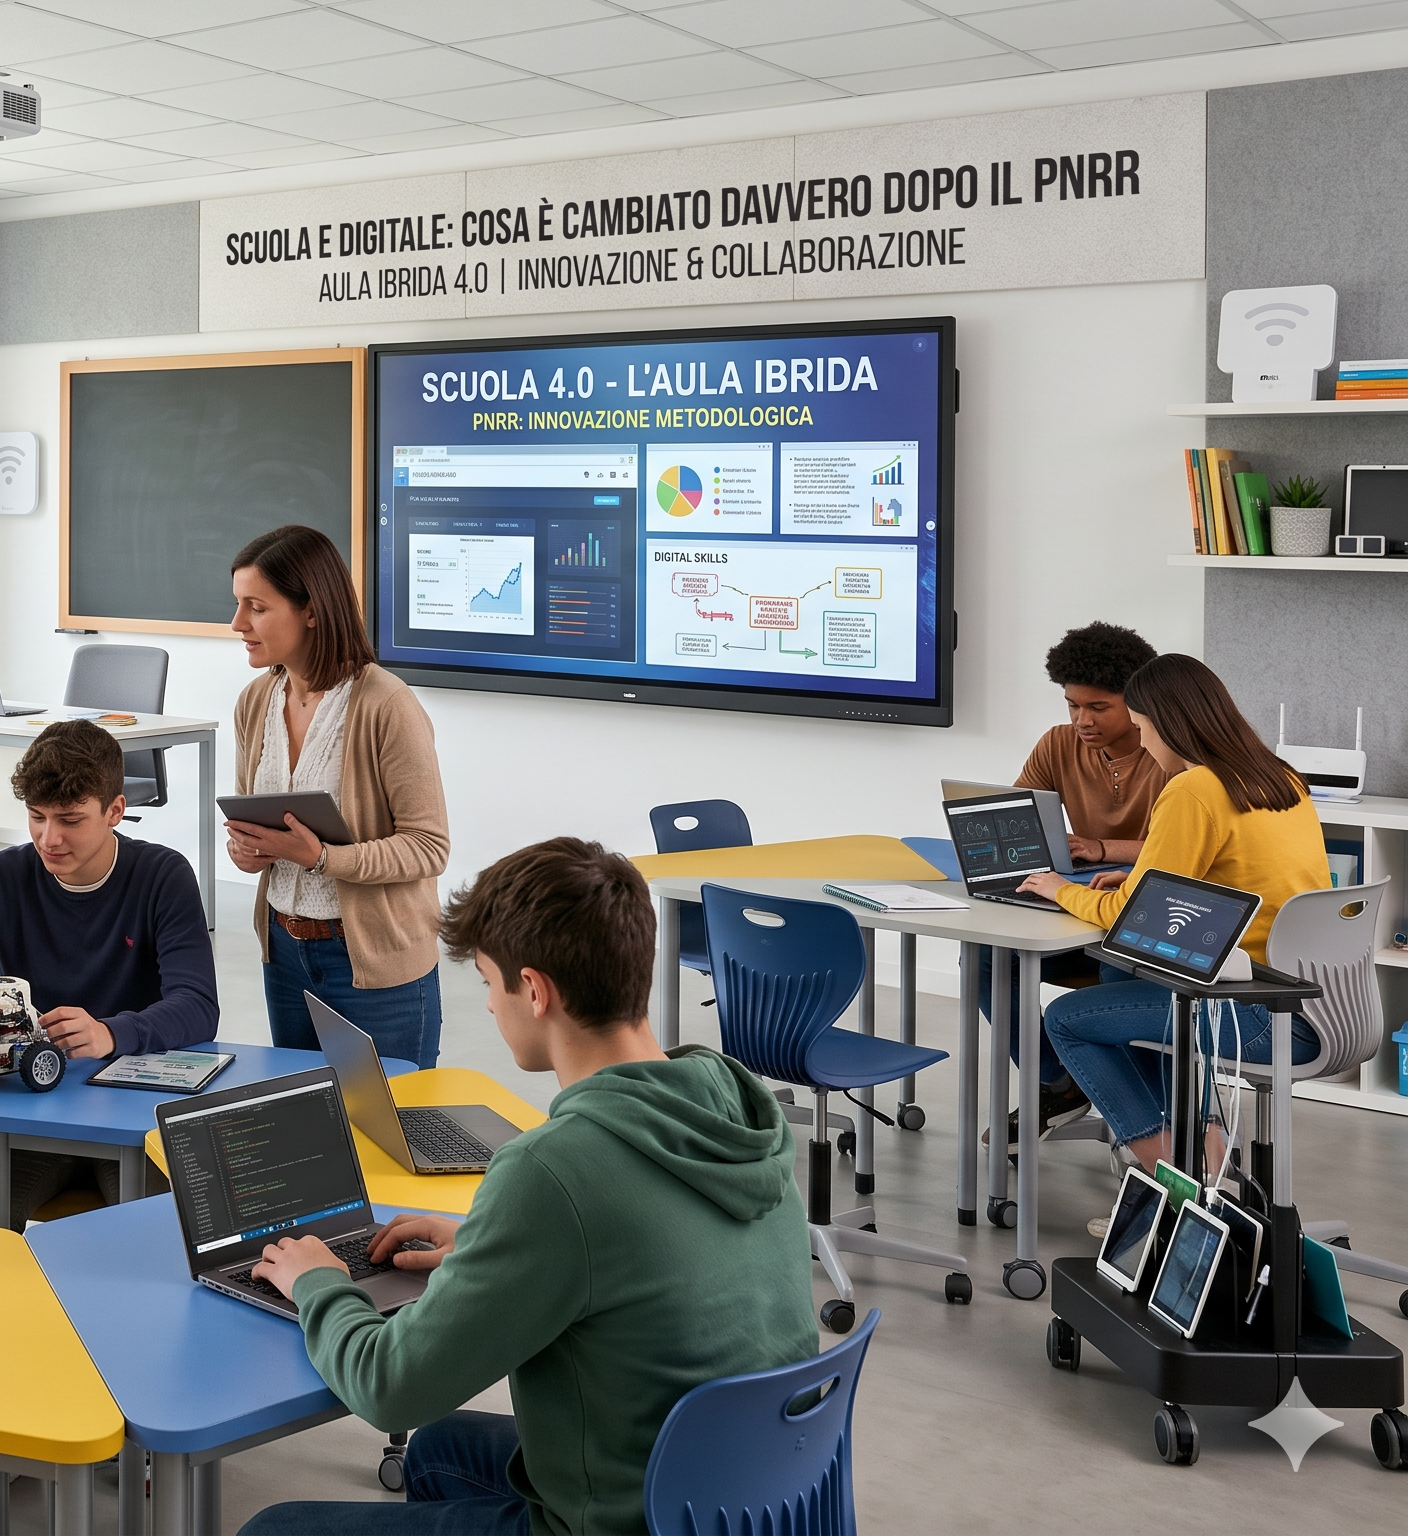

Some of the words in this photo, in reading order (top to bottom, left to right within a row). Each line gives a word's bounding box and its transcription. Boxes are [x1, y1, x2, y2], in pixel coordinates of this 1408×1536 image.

[226, 226, 312, 266] SCUOLA
[319, 224, 332, 259] E
[339, 213, 453, 257] DIGITALE:
[461, 206, 531, 248] COSA
[538, 197, 554, 242] È
[562, 189, 711, 240] CAMBIATO
[721, 174, 872, 228] DAVVERO
[883, 164, 978, 215] DOPO
[990, 161, 1023, 207] IL
[1034, 149, 1140, 203] PNRR
[319, 270, 372, 303] AULA
[378, 265, 448, 299] IBRIDA
[453, 261, 488, 294] 4.0
[518, 246, 678, 291] INNOVAZIONE
[687, 246, 704, 281] &
[712, 228, 966, 279] COLLABORAZIONE
[422, 368, 540, 403] SCUOLA
[548, 366, 595, 399] 4.0
[627, 360, 744, 397] L'AULA
[754, 356, 879, 394] IBRIDA
[473, 411, 524, 431] PNRR:
[527, 409, 651, 430] INNOVAZIONE
[655, 405, 814, 428] METODOLOGICA
[654, 550, 693, 563] DIGITAL
[694, 552, 729, 564] SKILLS
